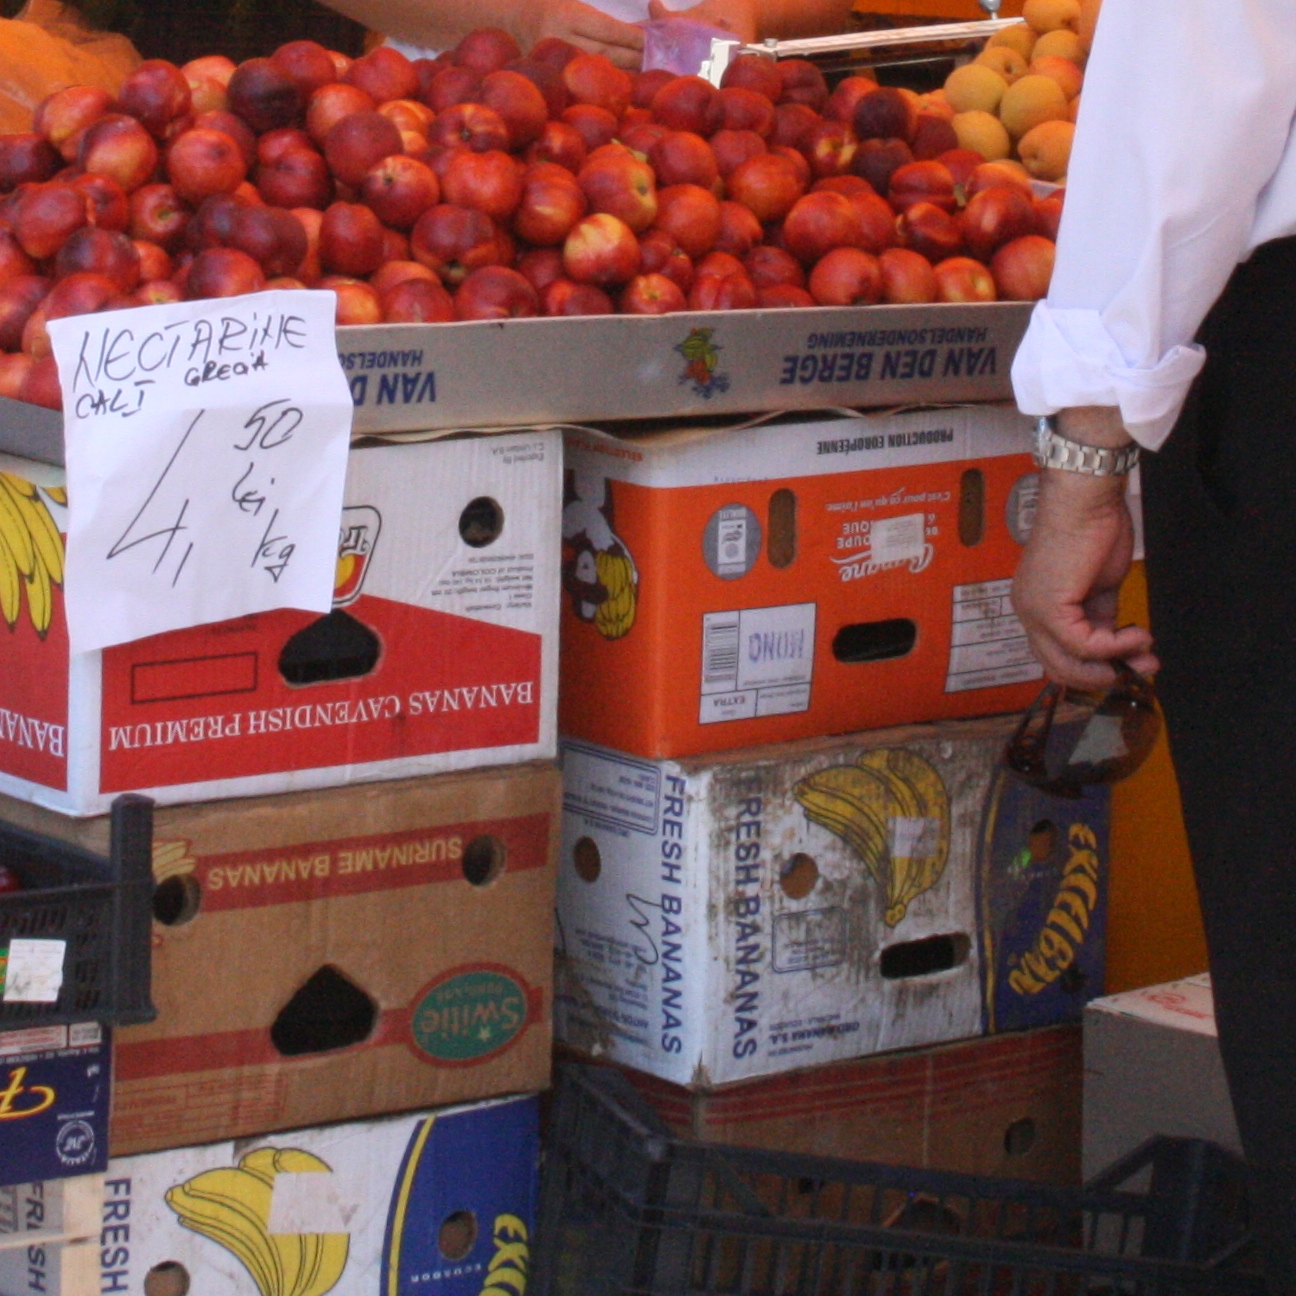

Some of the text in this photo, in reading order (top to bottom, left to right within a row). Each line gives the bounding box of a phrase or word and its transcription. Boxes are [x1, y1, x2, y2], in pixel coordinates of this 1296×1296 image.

[73, 312, 308, 394] NECTARINE
[806, 326, 989, 352] HANDELSONDERNEMING
[375, 369, 438, 404] VAN
[780, 345, 998, 386] VAN DEN BERGE
[888, 428, 953, 448] PRODUCTION
[107, 679, 534, 750] BANANAS CAVENDISH PREMIUM
[713, 695, 746, 707] EXTRA
[207, 834, 464, 891] SURINAME BANANAS
[659, 774, 687, 1056] FRESH BANANAS
[732, 893, 763, 1060] BANANAS
[101, 1176, 132, 1296] FRESH
[410, 1262, 482, 1284] ECUADOR
